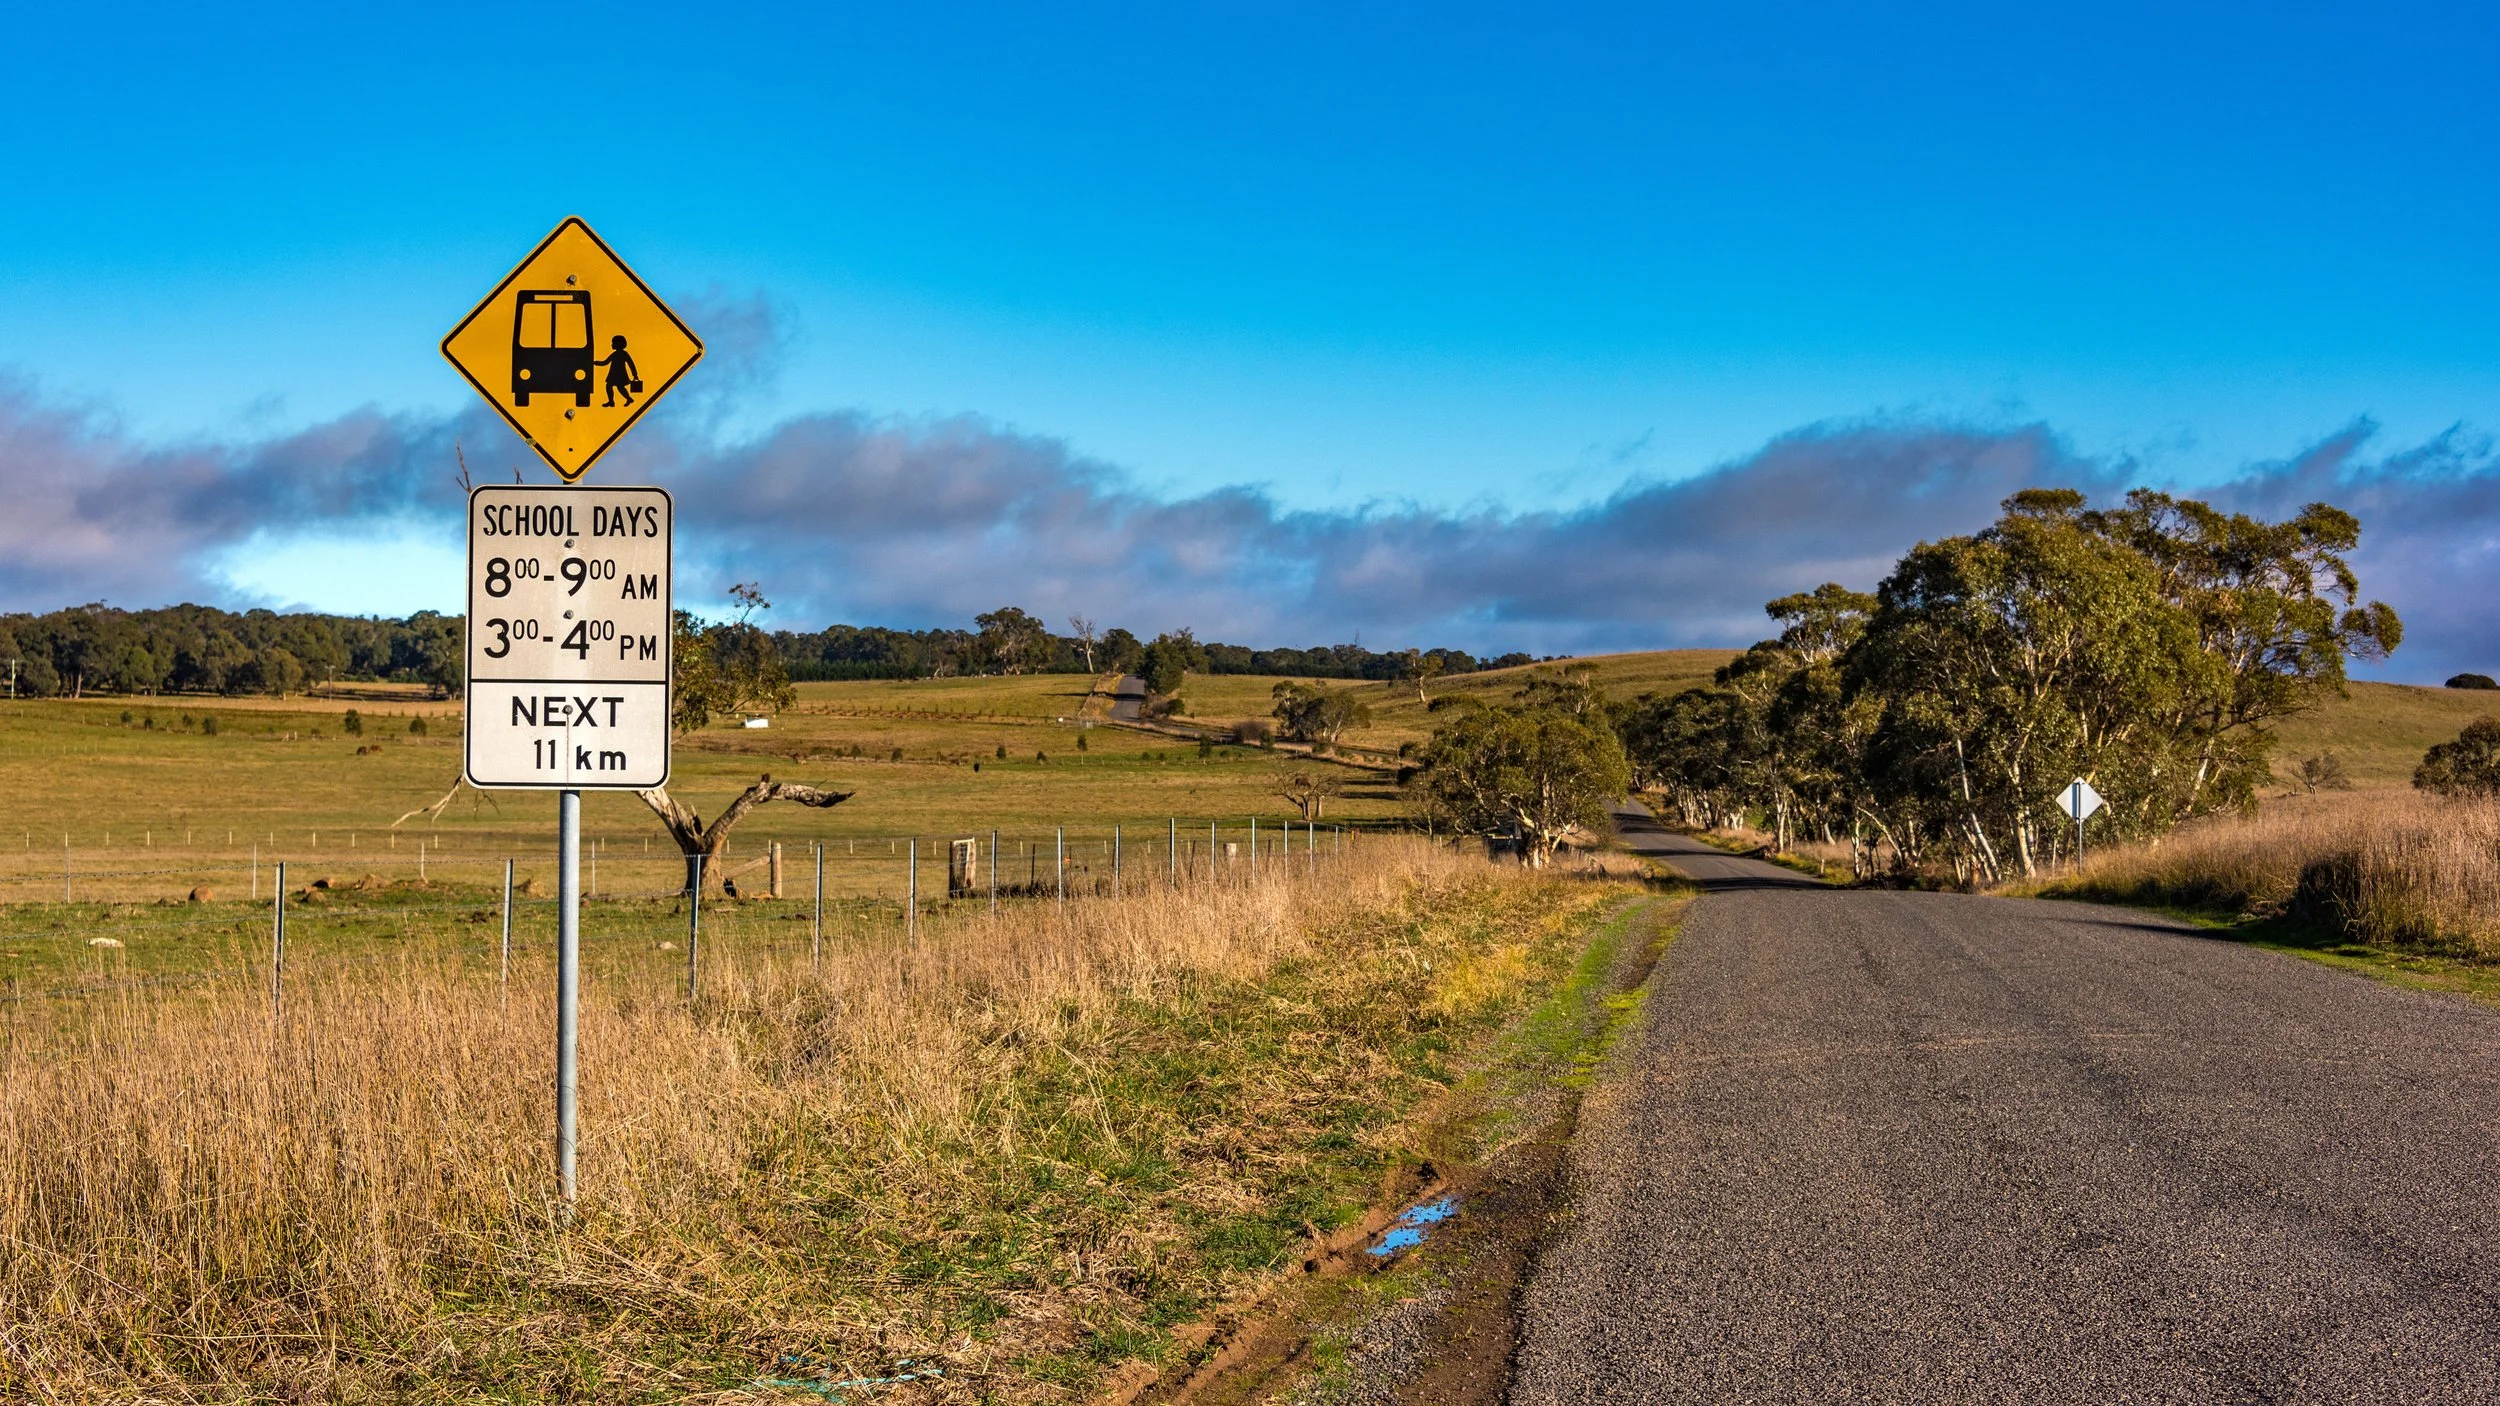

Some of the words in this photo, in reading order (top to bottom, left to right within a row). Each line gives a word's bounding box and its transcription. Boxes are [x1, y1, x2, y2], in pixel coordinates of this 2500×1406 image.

[483, 505, 579, 537] SCHOOL
[593, 506, 658, 538] DAYS
[621, 574, 658, 600] AM
[620, 635, 657, 661] PM
[512, 696, 624, 728] NEXT
[534, 739, 556, 770] 11
[576, 745, 627, 771] km
